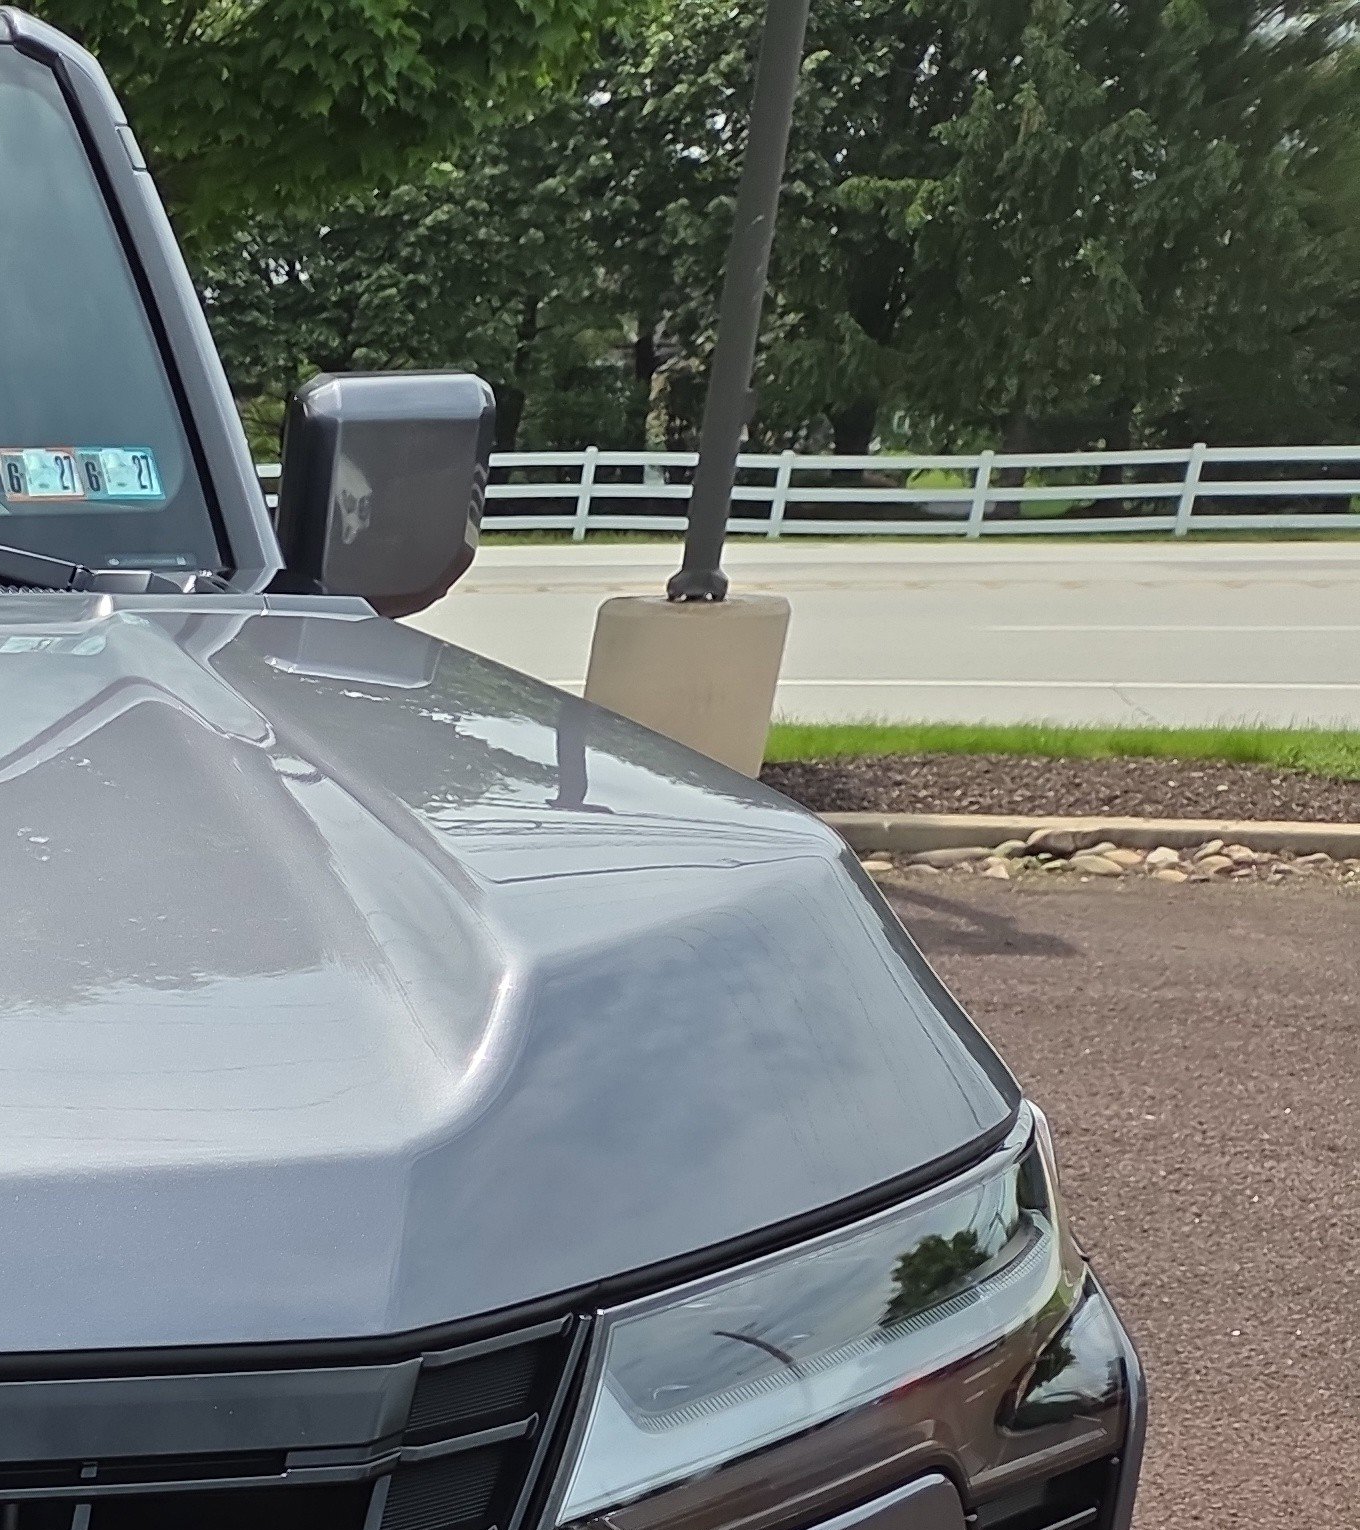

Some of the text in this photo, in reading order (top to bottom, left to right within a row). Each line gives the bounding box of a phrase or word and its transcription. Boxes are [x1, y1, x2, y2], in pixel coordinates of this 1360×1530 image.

[7, 455, 76, 493] 6 27
[84, 454, 154, 492] 6 27
